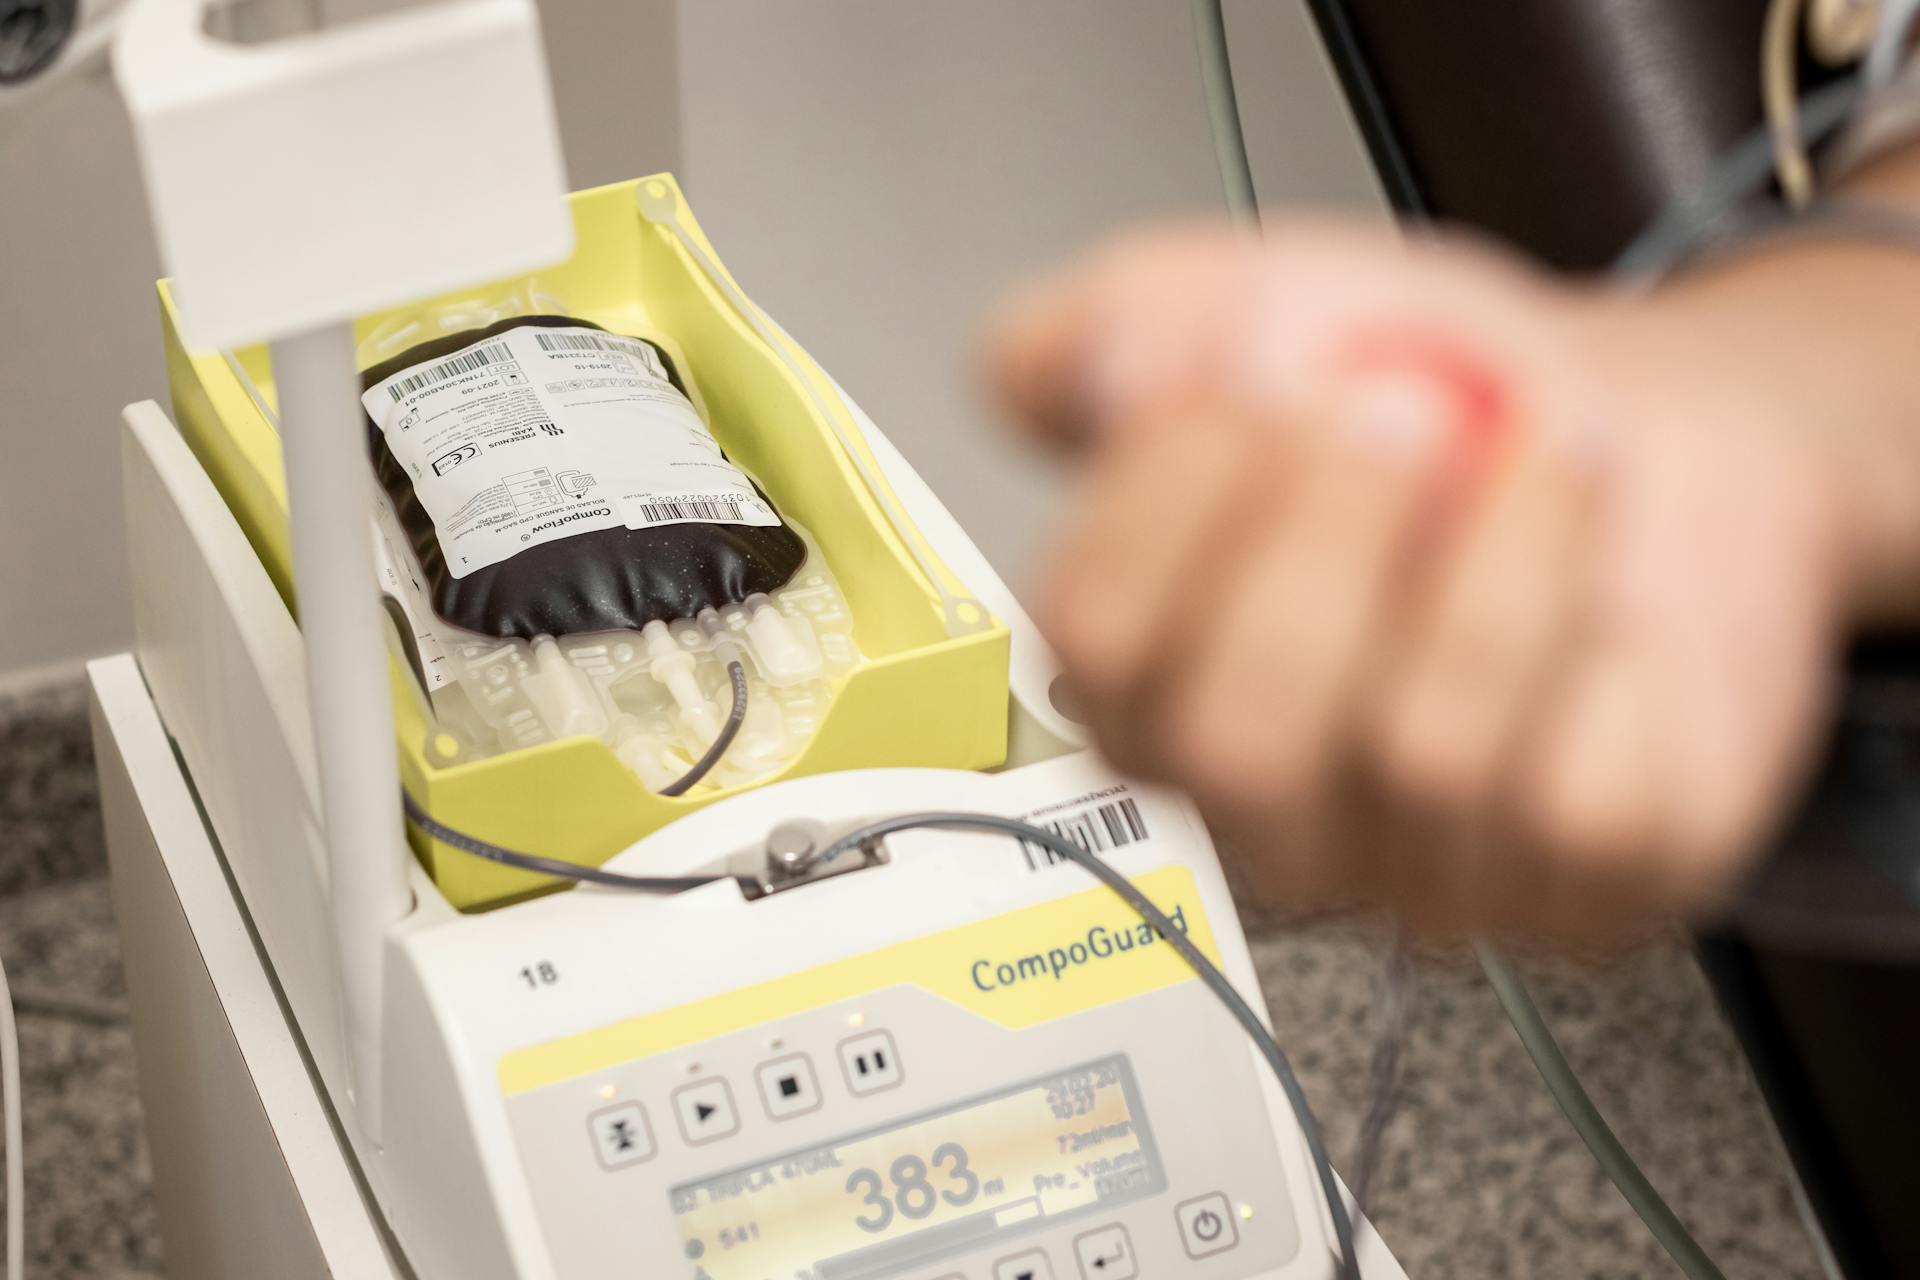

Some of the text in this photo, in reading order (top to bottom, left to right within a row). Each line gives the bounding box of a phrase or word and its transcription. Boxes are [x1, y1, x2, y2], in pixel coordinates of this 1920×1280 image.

[461, 379, 501, 395] 2021-09
[512, 427, 534, 437] KABI
[488, 432, 537, 449] FRESENIUS
[564, 503, 576, 512] DE
[575, 499, 606, 509] BOLSAS
[536, 506, 563, 518] SANGUE
[519, 515, 534, 526] CPD
[460, 555, 469, 564] 1
[518, 959, 559, 990] 18
[845, 1142, 980, 1234] 383
